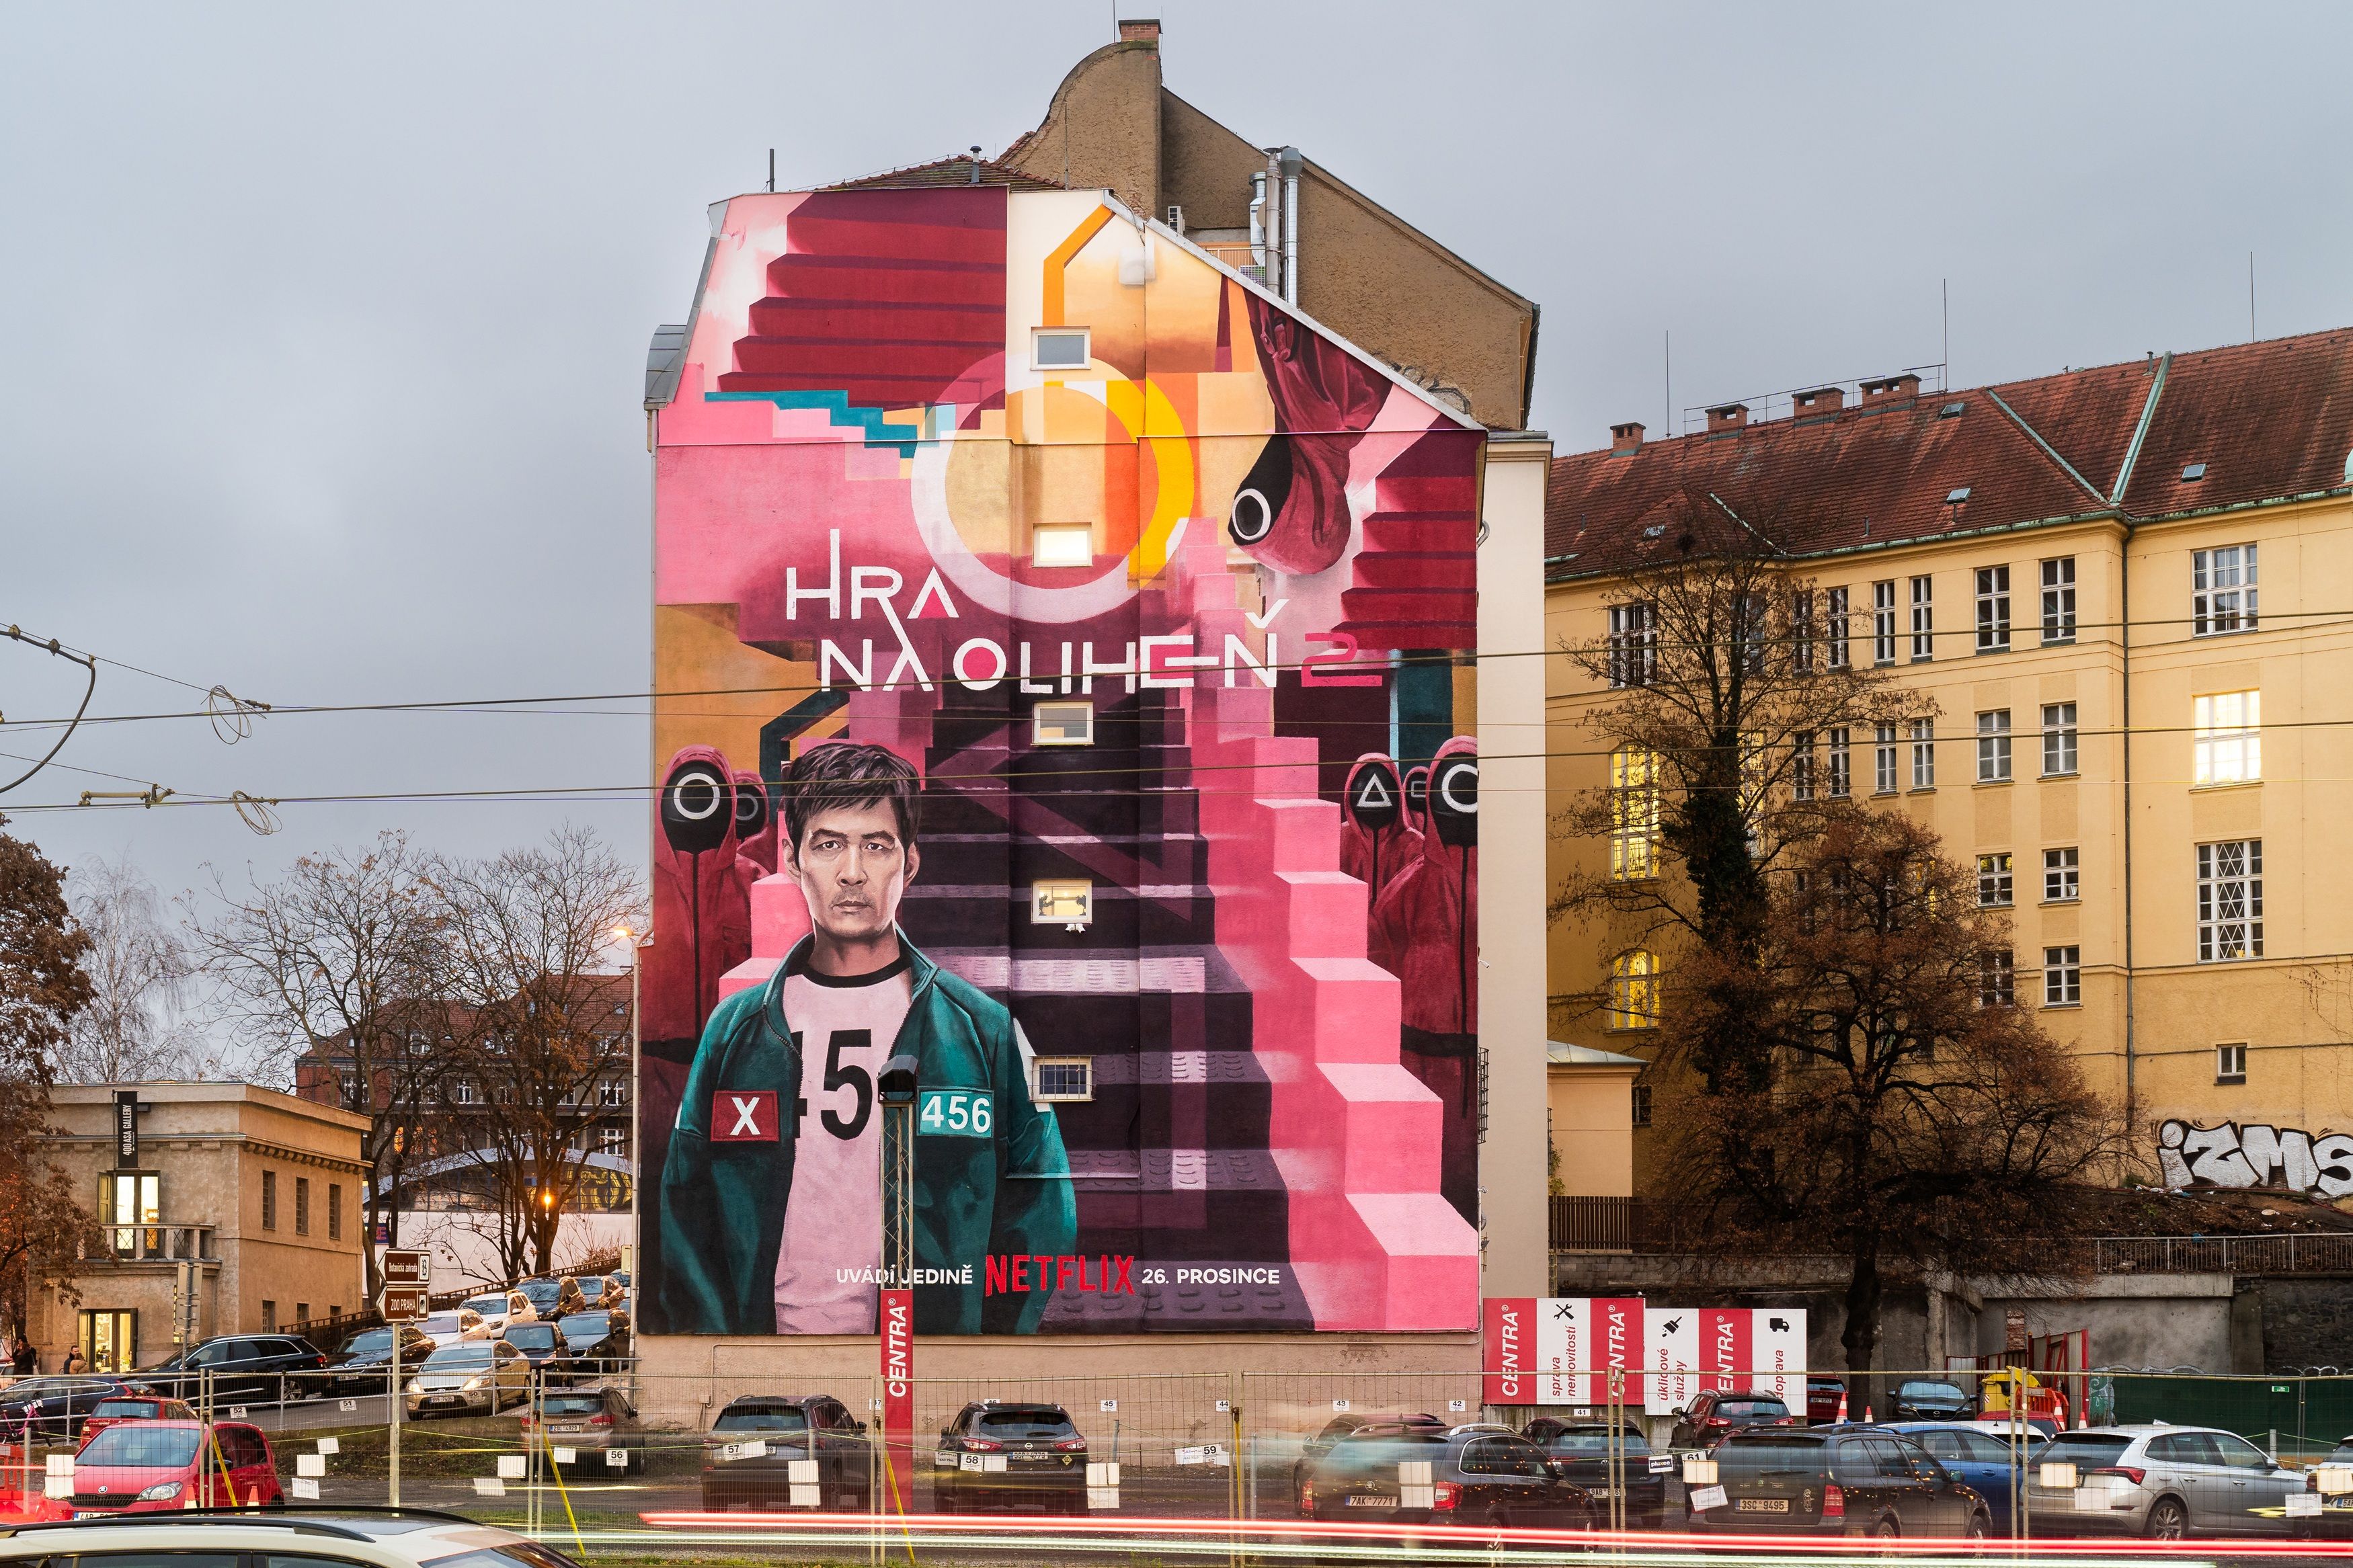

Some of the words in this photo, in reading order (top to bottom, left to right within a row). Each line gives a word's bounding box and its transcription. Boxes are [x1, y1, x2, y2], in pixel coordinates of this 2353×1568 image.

[787, 528, 959, 620] HRA
[821, 638, 934, 692] NA
[953, 598, 1289, 694] OLIHEŇ
[1301, 632, 1382, 687] 2
[122, 1104, 132, 1129] GALLERY
[729, 1097, 760, 1136] X
[921, 1096, 991, 1133] 456
[389, 1262, 404, 1272] Botanická
[405, 1263, 417, 1272] zahrada
[836, 1264, 895, 1284] UVÁDÍ
[901, 1264, 973, 1284] JEDINĚ
[985, 1254, 1136, 1296] NETFLIX
[1142, 1268, 1170, 1284] 26.
[1177, 1268, 1280, 1284] PROSINCE
[391, 1298, 400, 1311] ZOO
[401, 1298, 416, 1311] PRAHA
[728, 1444, 740, 1453] 57
[1203, 1446, 1217, 1455] 59
[610, 1450, 623, 1459] 56
[965, 1455, 979, 1464] 58
[1351, 1496, 1368, 1505] 7AK
[1373, 1496, 1393, 1505] 7771
[1763, 1501, 1785, 1510] 9495
